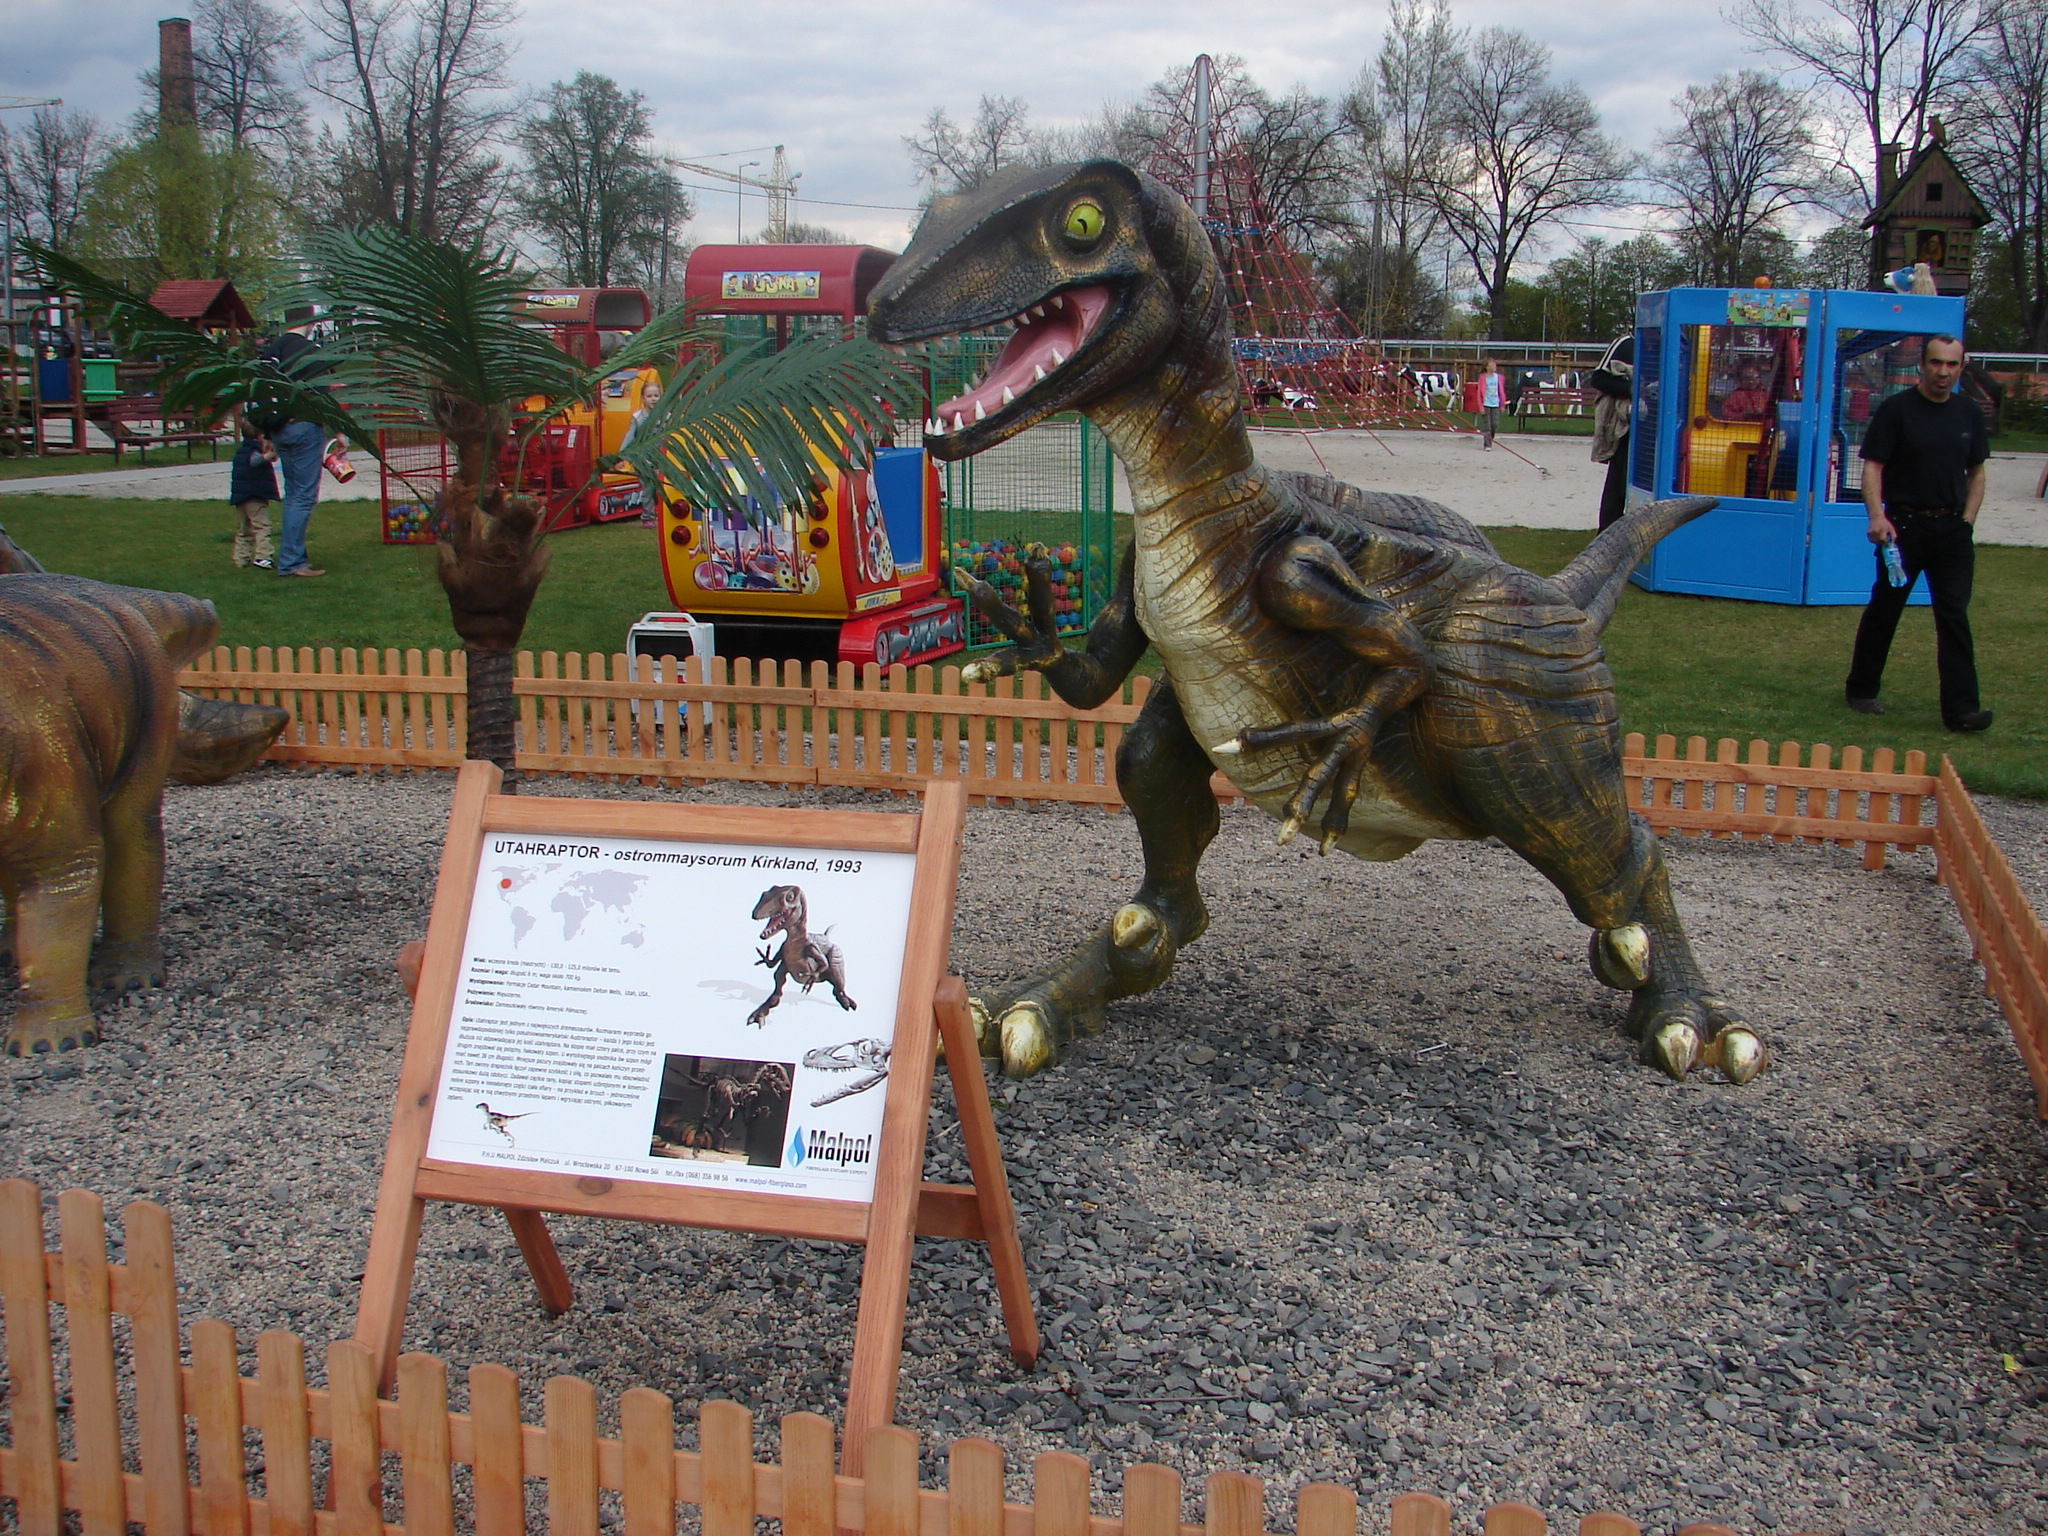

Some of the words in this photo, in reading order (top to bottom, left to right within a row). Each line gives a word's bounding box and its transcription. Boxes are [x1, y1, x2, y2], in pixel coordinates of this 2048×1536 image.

[495, 841, 599, 859] UTAHRAPTOR
[614, 850, 746, 869] ostrommaysorum
[751, 855, 818, 873] Kirkland,
[826, 859, 862, 874] 1993
[808, 1129, 872, 1167] Malpol
